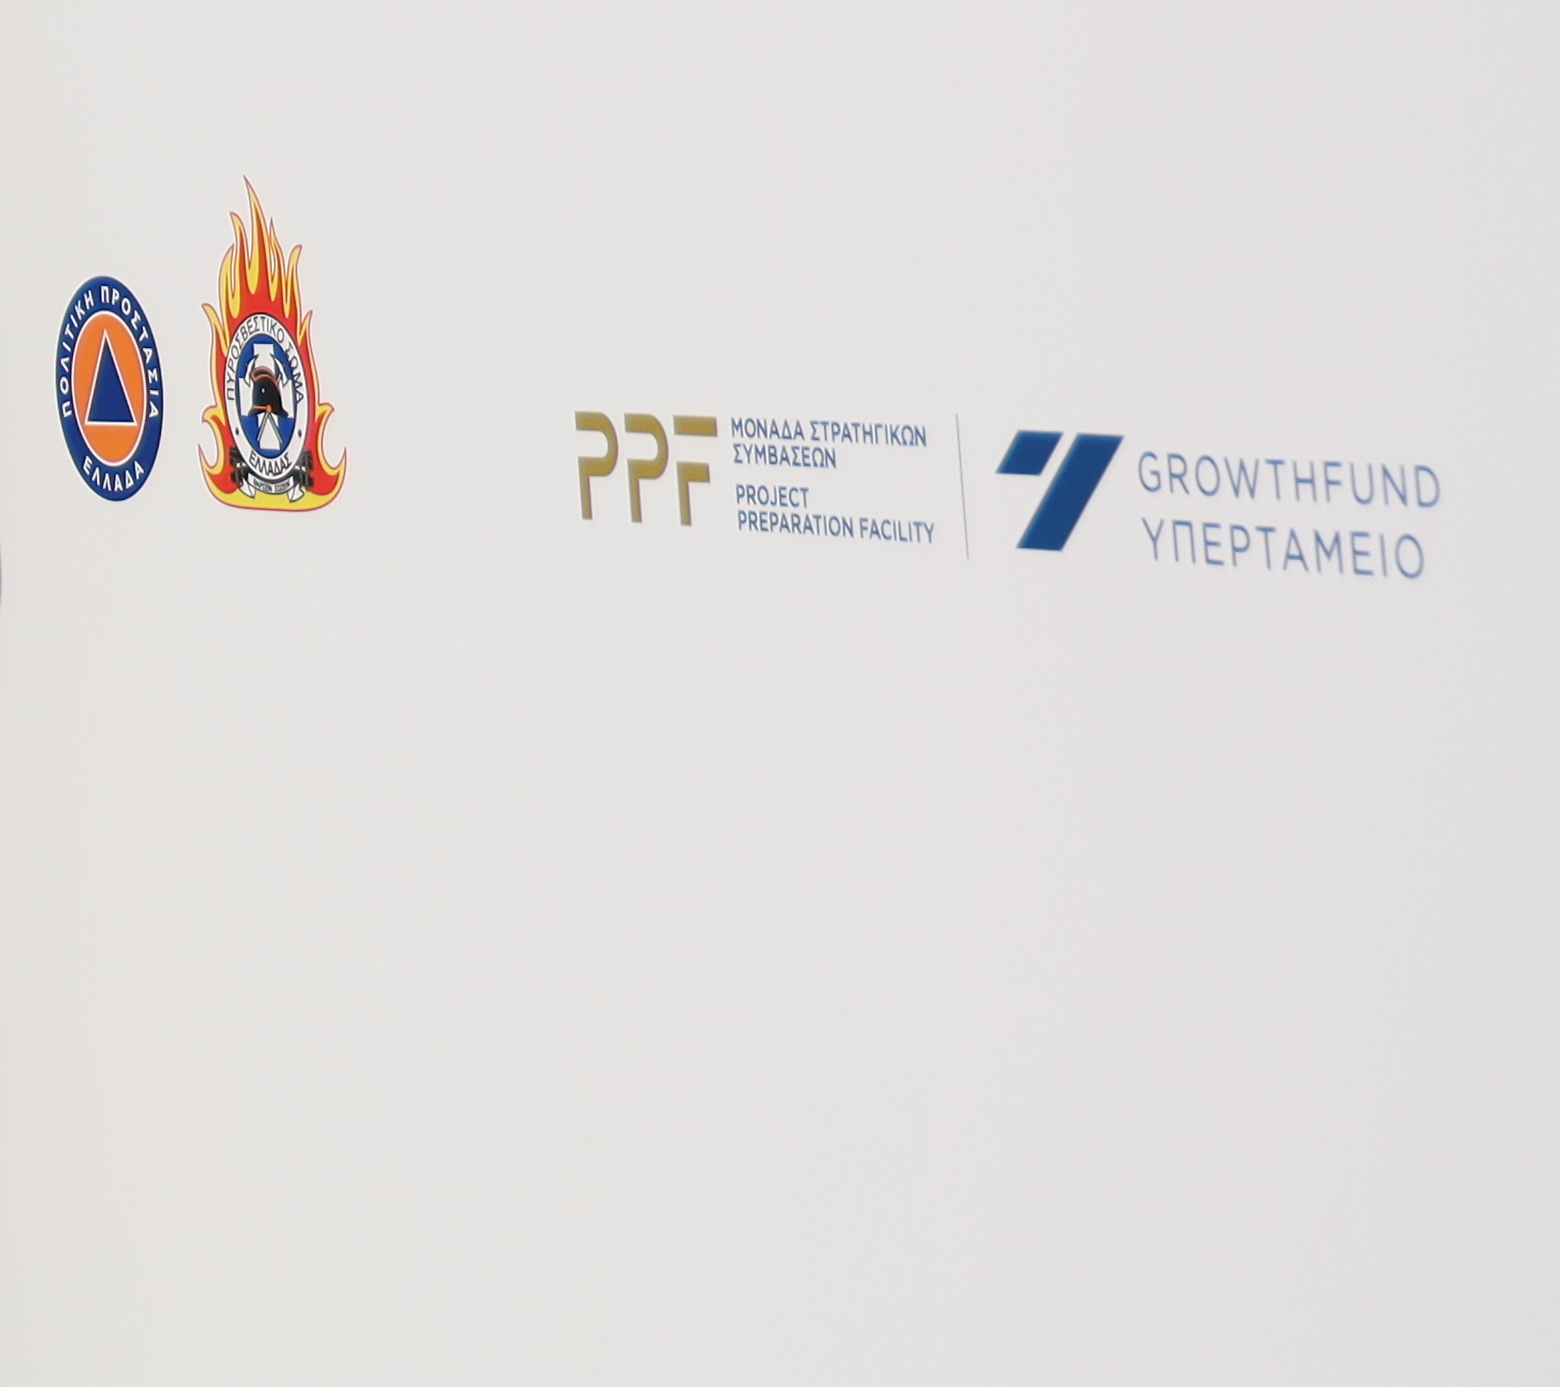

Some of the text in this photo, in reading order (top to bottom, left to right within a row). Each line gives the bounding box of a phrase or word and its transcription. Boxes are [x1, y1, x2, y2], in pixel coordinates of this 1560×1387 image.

[59, 284, 160, 420] ΠΟΛΙΤΙΚΗ ΠΡΟΣΤΑΣΙΑ
[226, 313, 306, 405] ΠΥΡΟΣΒΕΣΤΙΚΟ ΣΩΜΑ
[730, 416, 927, 448] ΜΟΝΑΔΑ ΣΤΡΑΤΗΓΙΚΩΝ
[733, 443, 837, 469] ΣΥΜΒΑΣΕΩΝ
[82, 455, 146, 493] ΕΛΛΑΔΑ
[574, 410, 719, 527] PPF
[1137, 450, 1442, 509] GROWTHFUND
[735, 483, 810, 509] PROJECT
[738, 510, 936, 545] PREPARATION FACILITY
[1141, 516, 1426, 581] ΥΠΕΡΤΑΜΕΙΟ
